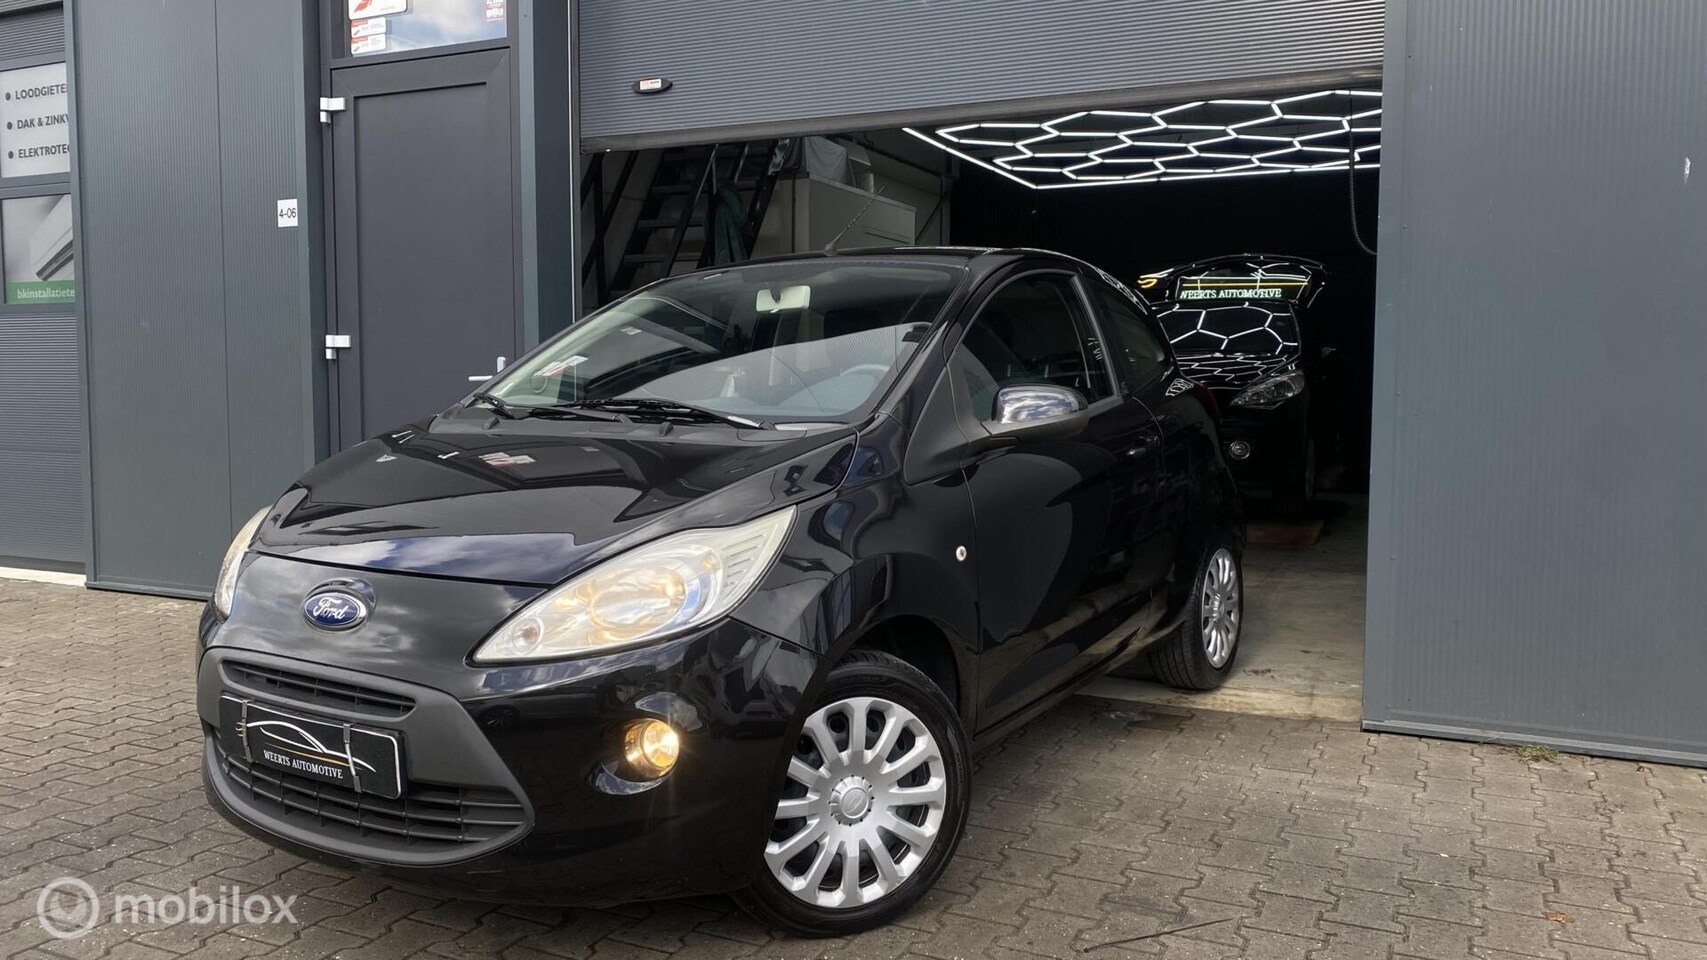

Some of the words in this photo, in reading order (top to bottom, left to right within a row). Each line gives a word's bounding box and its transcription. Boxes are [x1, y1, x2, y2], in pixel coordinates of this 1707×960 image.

[17, 118, 35, 130] DAK
[37, 117, 43, 127] &
[279, 207, 297, 219] 4-06
[1218, 288, 1282, 298] AUTOMOTIVE
[313, 597, 349, 619] Ford
[263, 749, 290, 767] WEERTS
[292, 759, 343, 779] AUTOMOTIVE
